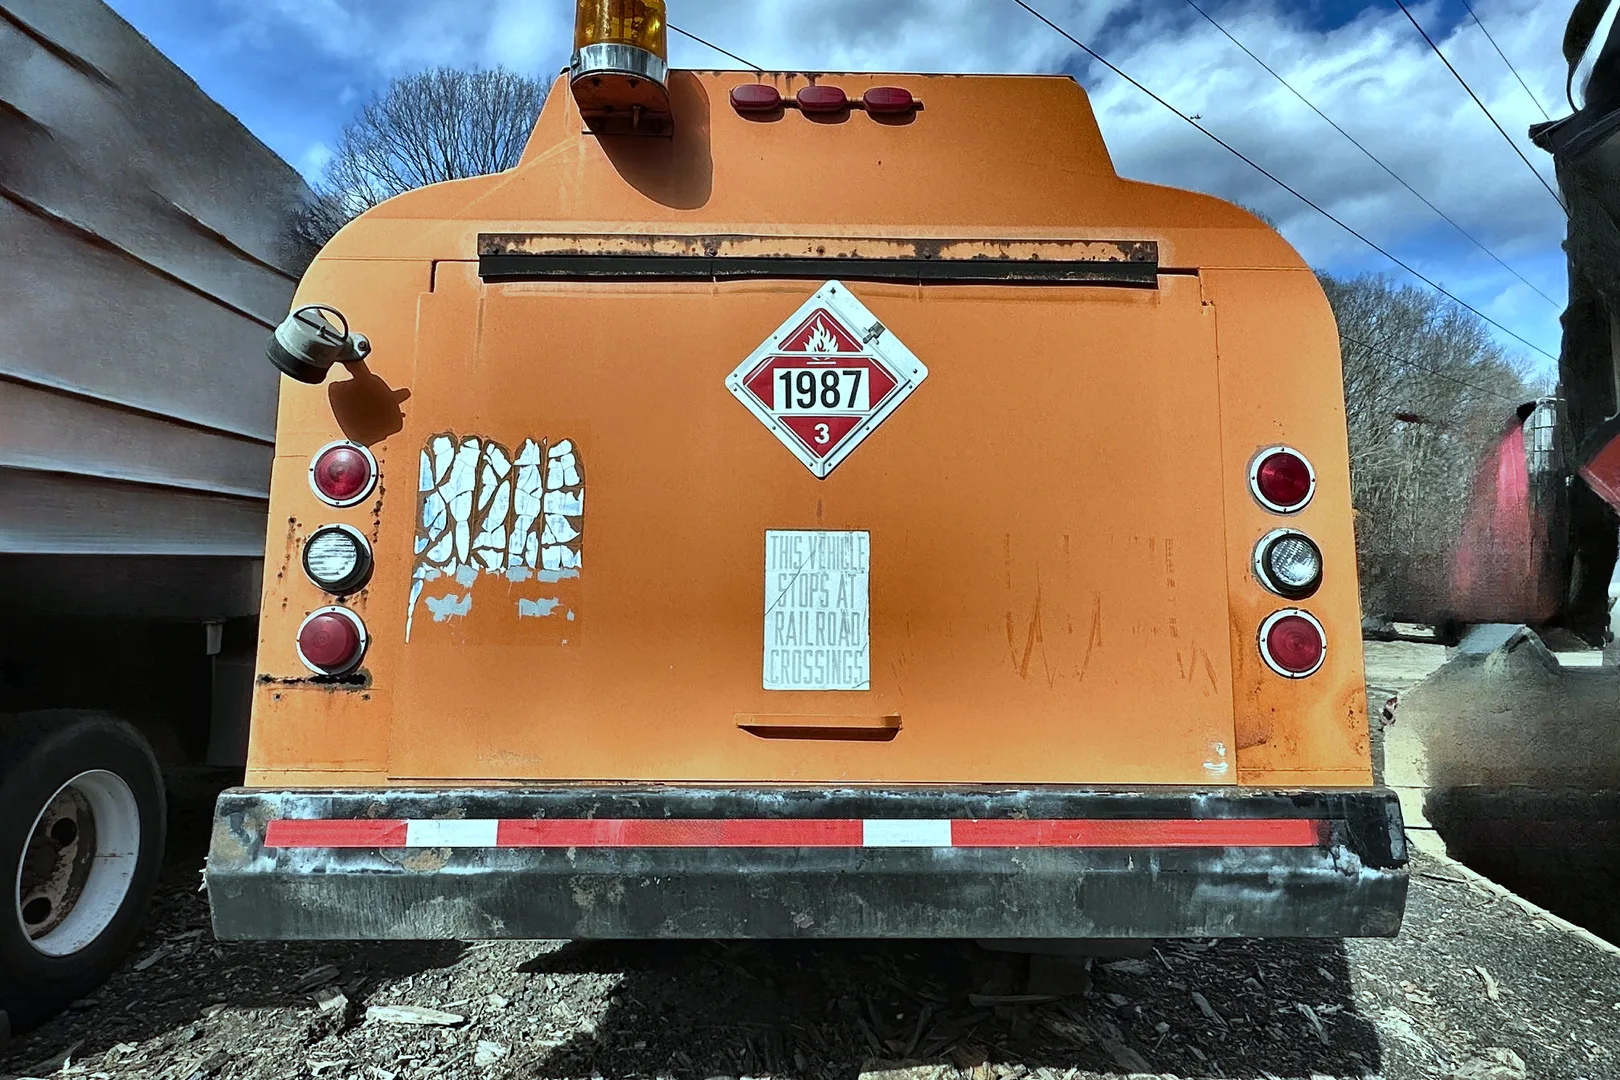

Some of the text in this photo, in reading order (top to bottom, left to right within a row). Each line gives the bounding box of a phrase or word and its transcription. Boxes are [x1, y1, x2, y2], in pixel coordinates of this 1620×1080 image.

[779, 370, 862, 409] 1987
[814, 423, 830, 444] 3
[770, 535, 866, 571] THIS VEHICLE
[777, 573, 856, 608] STOPS AT
[774, 611, 861, 646] RAILROAD
[770, 649, 863, 684] CROSSINGS
